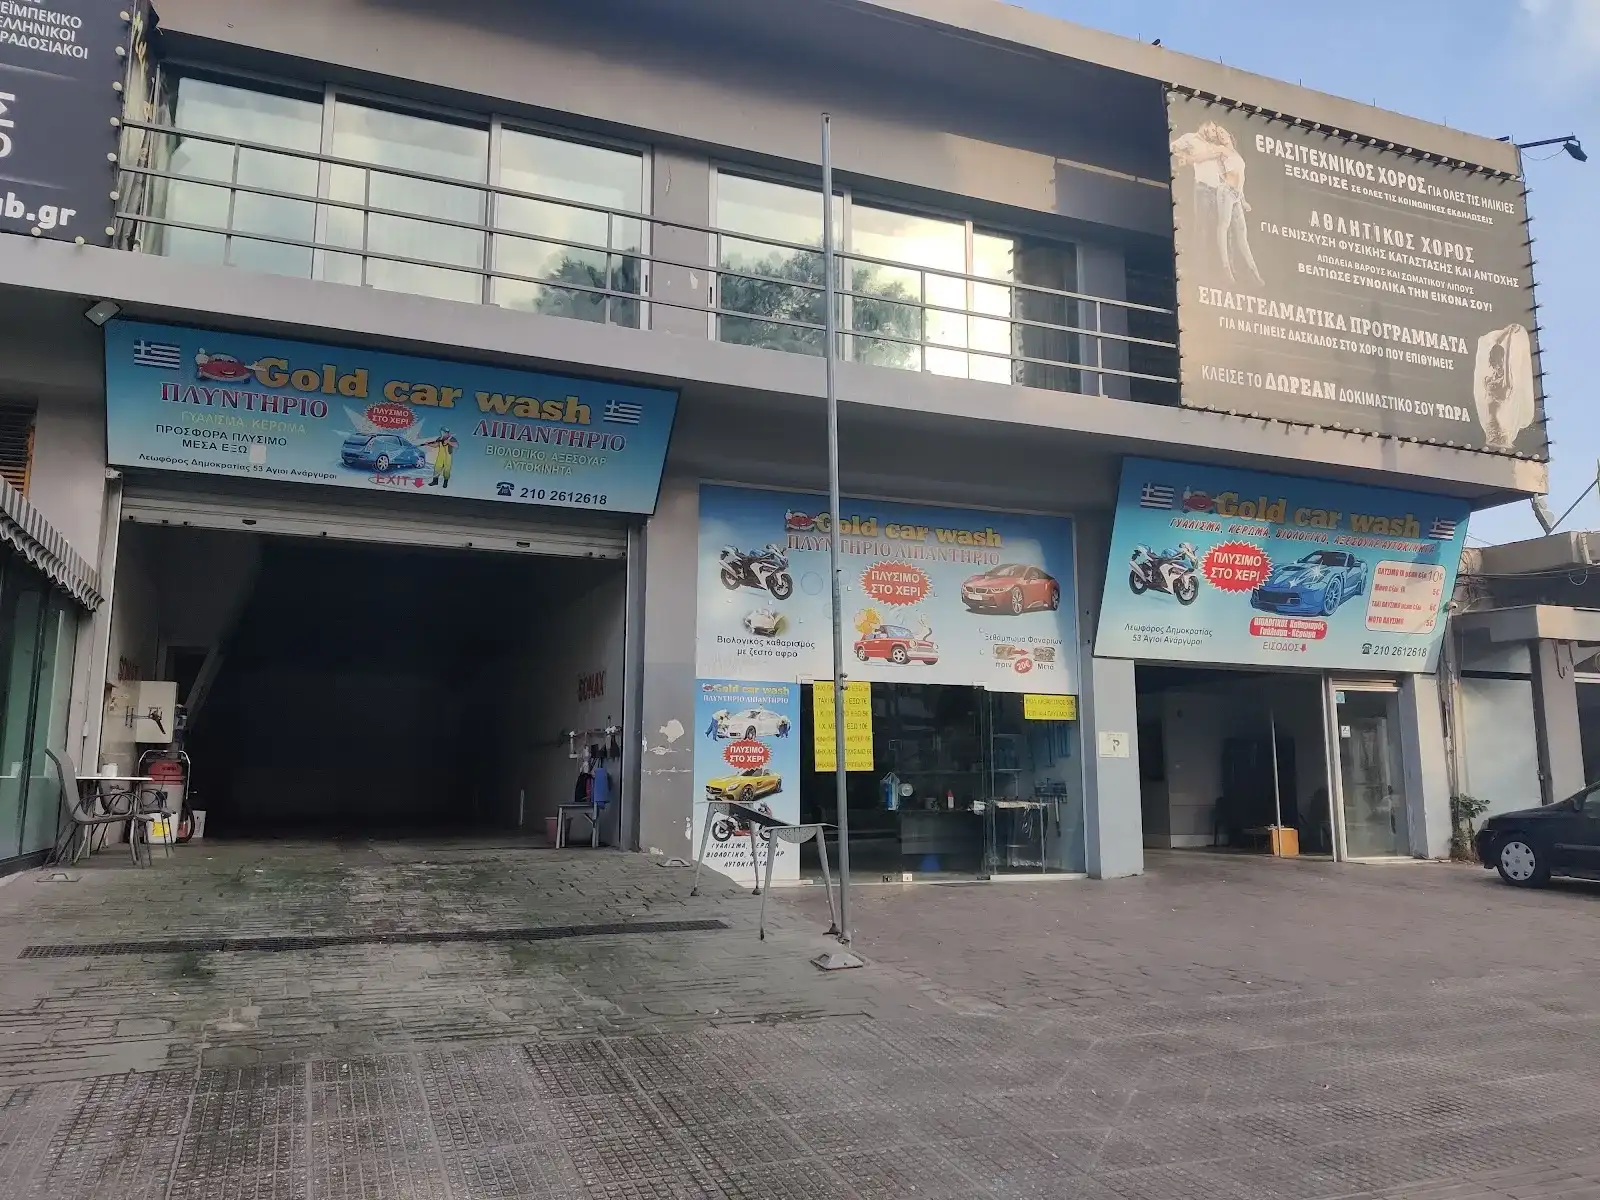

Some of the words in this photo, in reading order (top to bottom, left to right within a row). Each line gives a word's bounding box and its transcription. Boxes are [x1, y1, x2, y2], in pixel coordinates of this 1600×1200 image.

[0, 1, 82, 29] ΕΪΜΠΕΚΙΚΟ
[1255, 134, 1376, 182] ΕΡΑΣΙΤΕΧΝΙΚΟΣ
[1377, 166, 1427, 194] ΧΟΡΟΣ
[1428, 185, 1442, 198] ΓΙΑ
[1443, 188, 1466, 203] ΟΛΕΣ
[1466, 193, 1481, 206] ΤΙΣ
[1481, 198, 1515, 214] ΗΛΙΚΙΕΣ
[1284, 164, 1349, 191] ΞΕΧΩΡΙΣΕ
[1351, 184, 1362, 194] ΣΕ
[1362, 187, 1384, 199] ΟΛΕΣ
[1384, 193, 1397, 203] ΤΙΣ
[1398, 197, 1446, 214] ΚΟΙΝΩΝΙΚΕΣ
[1447, 207, 1494, 225] ΕΚΔΗΛΩΣΕΙΣ
[0, 191, 76, 229] b.gr
[1310, 210, 1415, 250] ΑΘΛΗΤΙΚΟΣ
[1420, 236, 1475, 263] ΧΟΡΟΣ
[1260, 221, 1279, 235] ΓΙΑ
[1281, 226, 1336, 248] ΕΝΙΣΧΥΣΗ
[1338, 239, 1387, 260] ΦΥΣΙΚΗΣ
[1388, 251, 1453, 274] ΚΑΤΑΣΤΑΣΗΣ
[1455, 265, 1472, 278] ΚΑΙ
[1474, 271, 1520, 288] ΑΝΤΟΧΗΣ
[1317, 254, 1354, 269] ΑΠΩΛΕΙΑ
[1354, 261, 1386, 276] ΒΑΡΟΥΣ
[1386, 269, 1400, 279] ΚΑΙ
[1401, 272, 1446, 289] ΣΩΜΑΤΙΚΟΥ
[1446, 282, 1475, 295] ΛΙΠΟΥΣ
[1298, 262, 1351, 283] ΒΕΛΤΙΩΣΕ
[1353, 274, 1407, 295] ΣΥΝΟΛΙΚΑ
[1407, 286, 1429, 300] ΤΗΝ
[1431, 291, 1469, 308] ΕΙΚΟΝΑ
[1470, 299, 1493, 312] ΣΟΥ!
[1198, 285, 1347, 332] ΕΠΑΓΓΕΛΜΑΤΙΚΑ
[1349, 316, 1469, 355] ΠΡΟΓΡΑΜΜΑΤΑ
[1219, 316, 1236, 330] ΓΙΑ
[1237, 319, 1252, 333] ΝΑ
[1253, 322, 1287, 339] ΓΙΝΕΙΣ
[1288, 329, 1339, 349] ΔΑΣΚΑΛΟΣ
[1339, 338, 1358, 353] ΣΤΟ
[1359, 342, 1384, 357] ΧΟΡΟ
[1385, 347, 1404, 361] ΠΟΥ
[1405, 351, 1454, 370] ΕΠΙΘΥΜΕΙΣ
[160, 382, 329, 418] ΠΛΥΝΤΗΡΙΟ
[254, 357, 368, 398] Gold
[383, 379, 463, 408] car
[474, 389, 592, 425] wash
[1201, 364, 1245, 386] ΚΛΕΙΣΕ
[1246, 372, 1262, 388] ΤΟ
[1265, 372, 1336, 400] ΔΩΡΕΑΝ
[1339, 388, 1413, 413] ΔΟΚΙΜΑΣΤΙΚΟ
[1414, 400, 1434, 417] ΣΟΥ
[1436, 403, 1471, 423] ΤΩΡΑ
[372, 415, 389, 423] ΣΤΟ
[390, 416, 409, 425] ΧΕΡΙ
[373, 407, 409, 418] ΠΛΥΣΙΜΟ
[156, 424, 229, 441] ΠΡΟΣΦΟΡΑ
[232, 432, 288, 447] ΠΛΥΣΙΜΟ
[252, 419, 307, 435] ΚΕΡΩΜΑ
[472, 419, 627, 453] ΛΙΠΑΝΤΗΡΙΟ
[182, 439, 218, 451] ΜΕΣΑ
[221, 443, 248, 454] ΕΞΩ
[138, 452, 189, 466] Λεωφόρος
[191, 458, 251, 473] Δημοκρατίας
[252, 464, 264, 473] 53
[504, 460, 573, 477] ΑΥΤΟΚΙΝΗΤΑ
[551, 452, 608, 467] ΑΞΕΣΟΥΑΡ
[375, 472, 409, 486] EXIT
[520, 487, 546, 500] 210
[549, 489, 608, 506] 2612618
[1216, 491, 1287, 524] Gold
[1294, 506, 1343, 530] car
[1350, 512, 1421, 539] wash
[816, 511, 879, 538] Gold
[885, 523, 930, 541] car
[935, 527, 1004, 548] wash
[894, 543, 1001, 566] ΛΙΠΑΝΤΗΡΙΟ
[1213, 551, 1262, 567] ΠΛΥΣΙΜΟ
[871, 570, 921, 583] ΠΛΥΣΙΜΟ
[1210, 566, 1234, 581] ΣΤΟ
[1235, 568, 1260, 582] ΧΕΡΙ
[871, 583, 894, 595] ΣΤΟ
[895, 584, 921, 597] ΧΕΡΙ
[1132, 634, 1142, 643] 53
[1262, 641, 1300, 652] ΕΙΣΟΔΟΣ
[737, 649, 746, 657] με
[1373, 645, 1390, 656] 210
[1391, 646, 1428, 658] 2612618
[1016, 660, 1031, 671] 20€
[729, 754, 745, 763] ΣΤΟ
[746, 755, 765, 763] ΧΕΡΙ
[730, 746, 764, 754] ΠΛΥΣΙΜΟ
